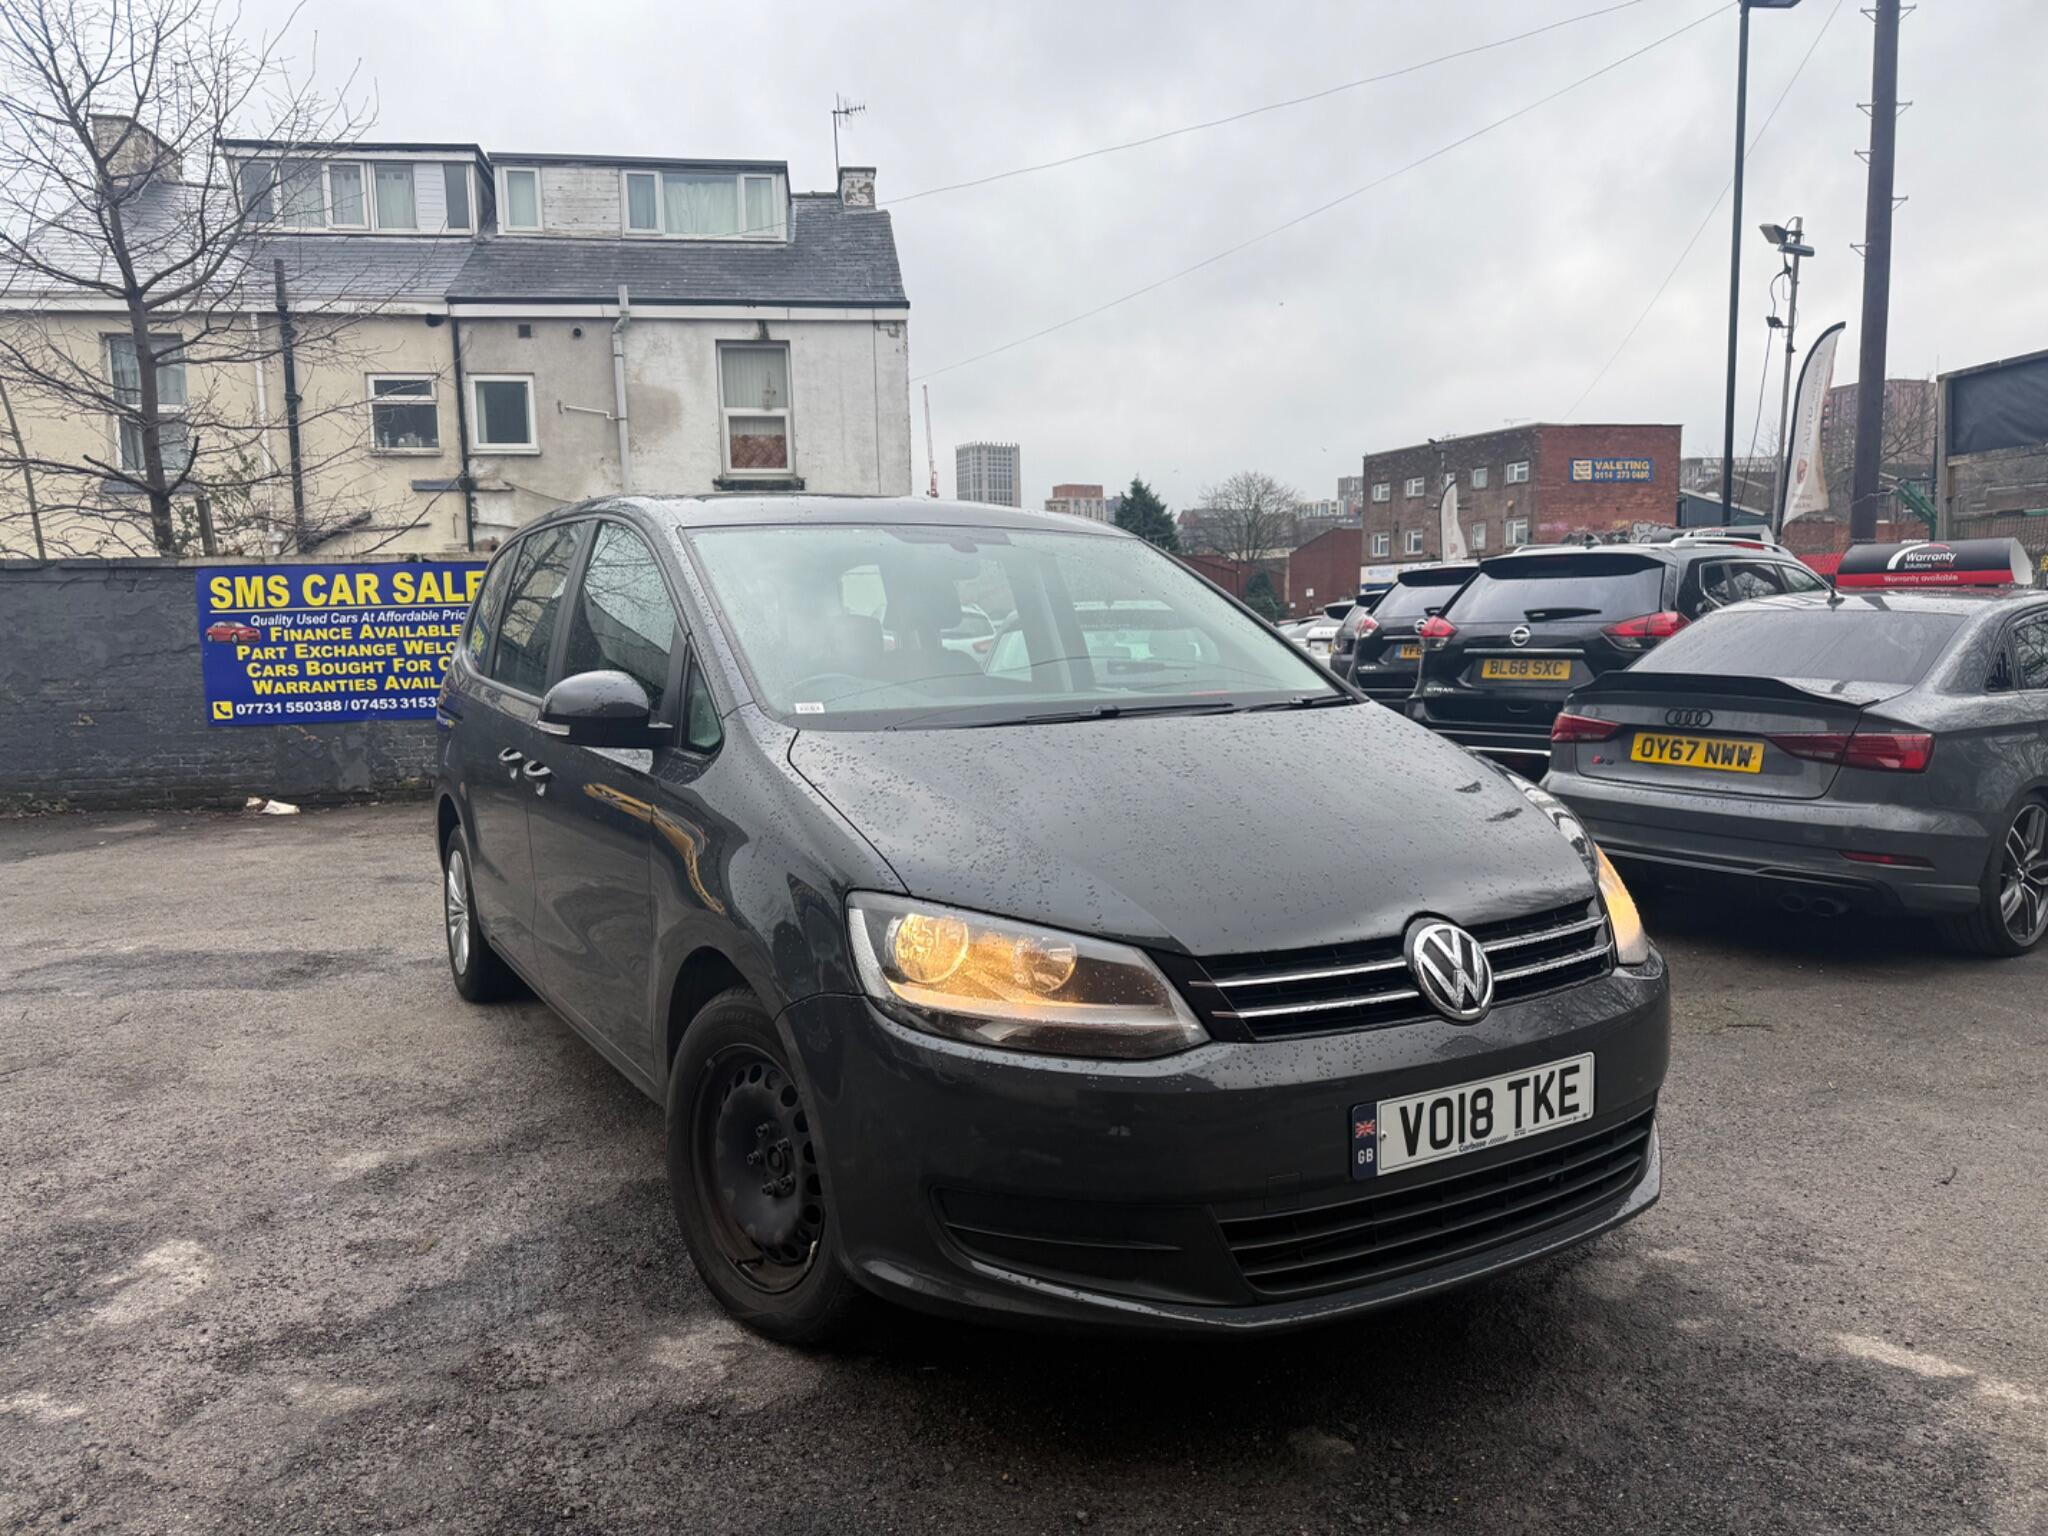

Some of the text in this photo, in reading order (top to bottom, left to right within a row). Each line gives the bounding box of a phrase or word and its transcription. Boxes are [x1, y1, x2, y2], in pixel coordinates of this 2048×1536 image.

[1595, 461, 1649, 470] VALETING
[1906, 552, 1957, 563] Warranty
[1883, 574, 1959, 583] Warranty available
[210, 575, 290, 609] SMS
[302, 573, 381, 606] CAR
[250, 614, 293, 627] Quality
[296, 613, 328, 625] Used
[330, 612, 358, 624] Cars
[360, 612, 375, 622] At
[377, 610, 439, 622] Affordable
[270, 624, 461, 642] FINANCE AVAILABLE
[237, 645, 287, 660] PART
[295, 643, 398, 658] EXCHANGE
[246, 661, 299, 678] CARS
[305, 660, 386, 676] BOUGHT
[393, 658, 432, 673] FOR
[1489, 660, 1563, 675] BL68 SXC
[252, 678, 378, 695] WARRANTIES
[236, 702, 282, 715] 07731
[286, 700, 342, 713] 550388
[350, 699, 398, 711] 07453
[400, 697, 440, 709] 3153
[1640, 736, 1700, 762] OY67
[1703, 742, 1753, 768] NWW
[1400, 1064, 1580, 1157] VO18 TKE
[1358, 1148, 1374, 1164] GB
